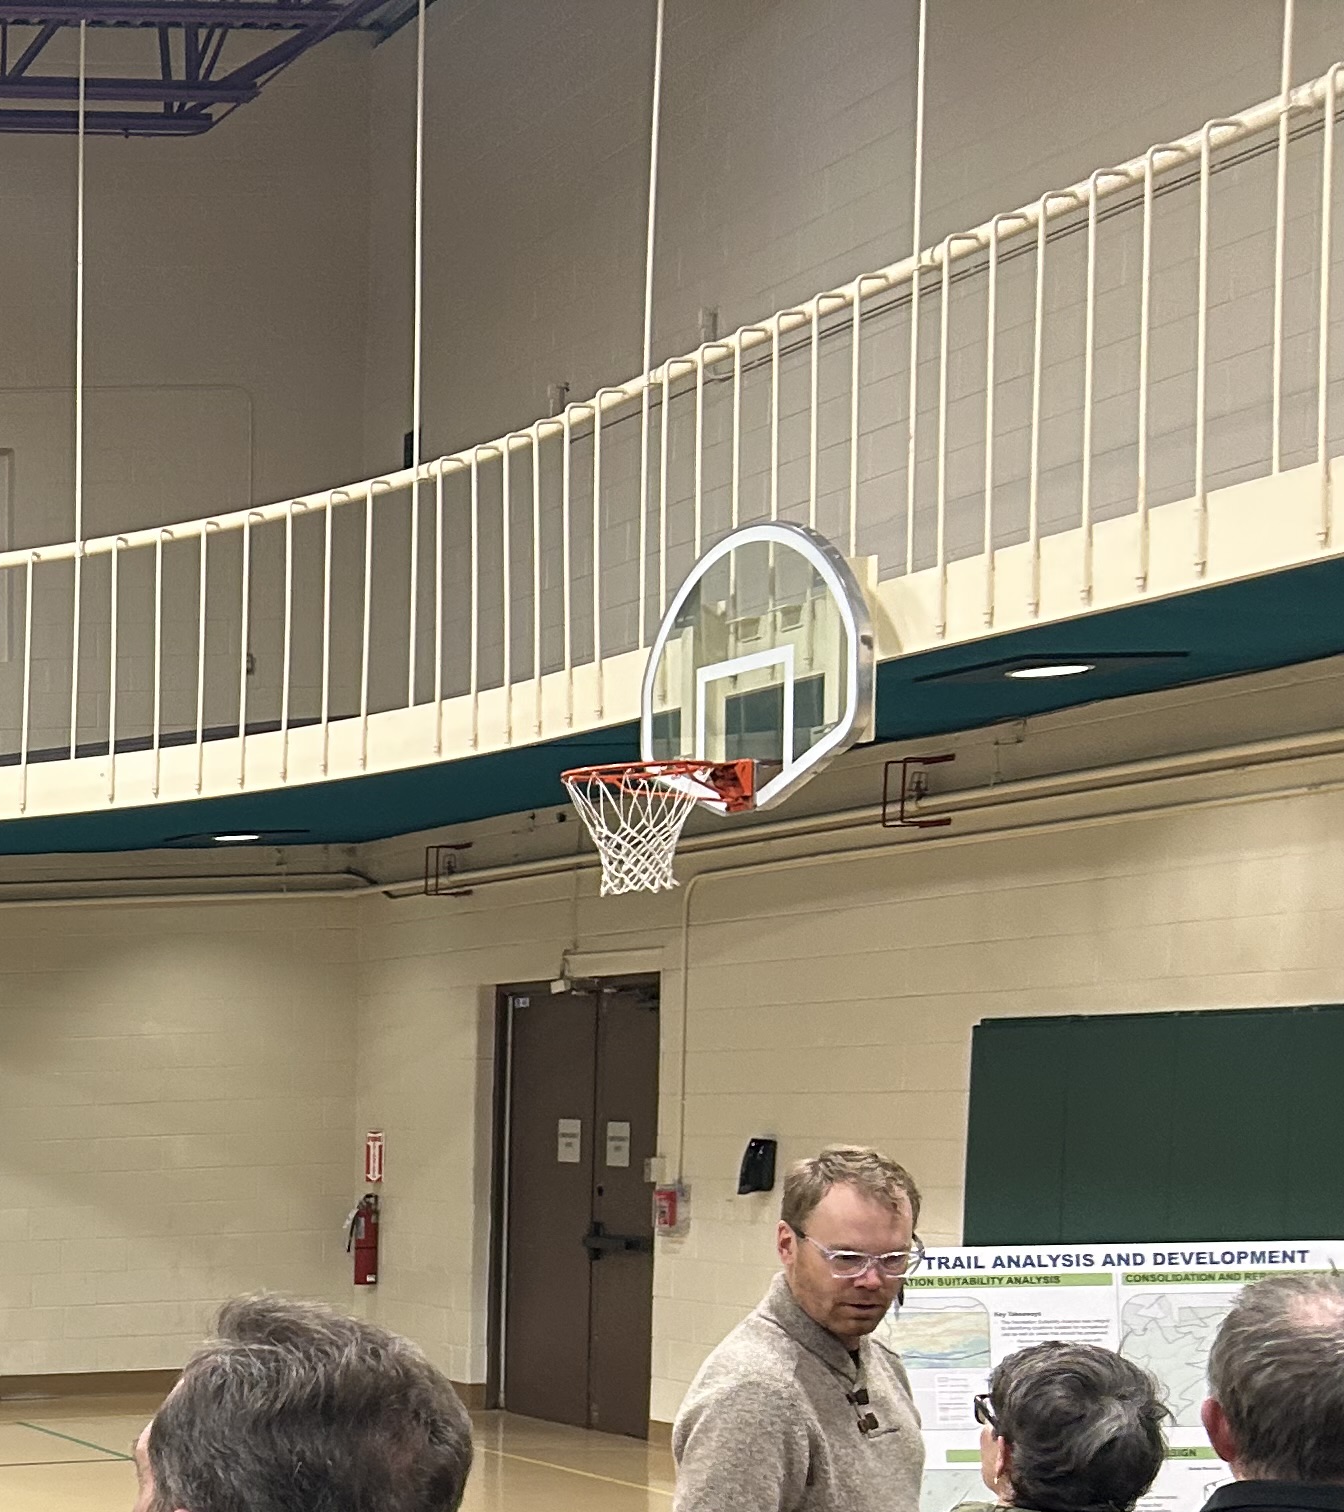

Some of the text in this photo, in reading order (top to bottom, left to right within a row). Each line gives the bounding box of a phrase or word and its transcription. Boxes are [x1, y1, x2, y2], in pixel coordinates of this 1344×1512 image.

[924, 1250, 1310, 1270] TRAIL ANALYSIS AND DEVELOPMENT
[937, 1276, 1004, 1286] SUITABILITY
[1005, 1275, 1061, 1285] ANALYSIS
[1125, 1273, 1218, 1283] CONSOLIDATION
[1218, 1272, 1241, 1281] AND
